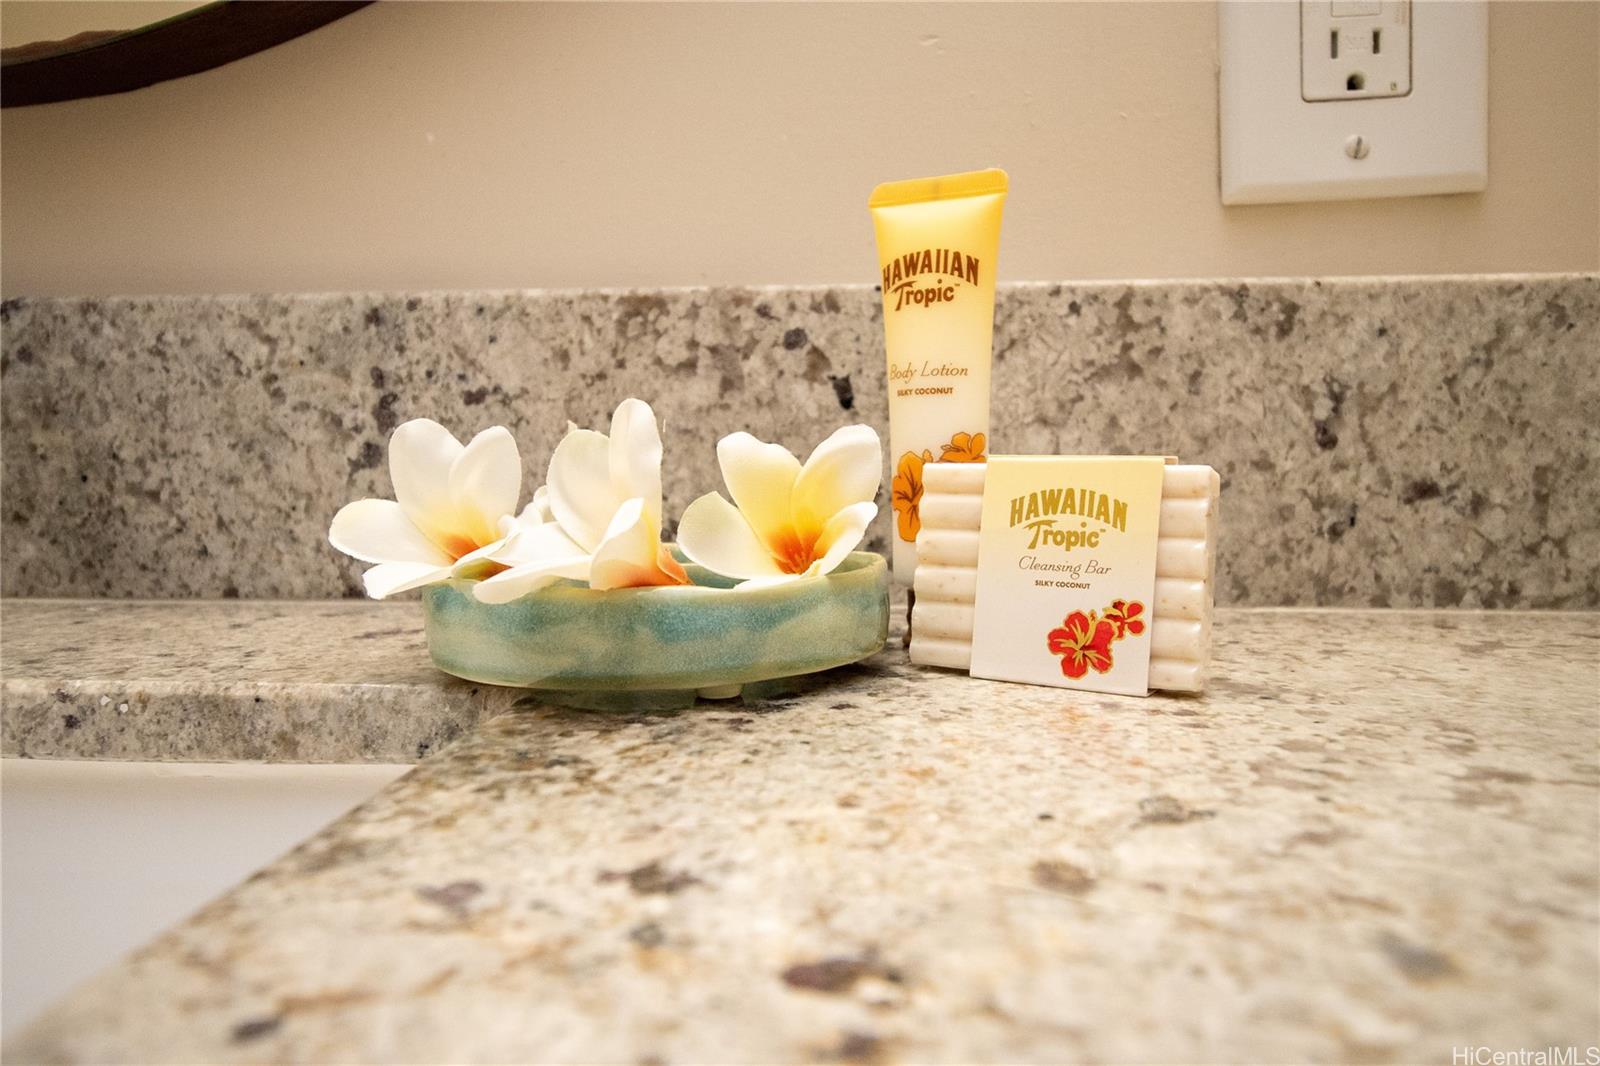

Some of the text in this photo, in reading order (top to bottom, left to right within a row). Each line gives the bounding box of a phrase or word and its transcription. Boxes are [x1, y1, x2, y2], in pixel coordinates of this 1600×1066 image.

[883, 249, 980, 295] HAWAIIAN
[890, 360, 969, 384] Body Lotion
[915, 387, 954, 396] COCONUT
[1009, 488, 1129, 533] HAWAIIAN
[1018, 555, 1112, 580] Cleansing Bar
[1035, 579, 1091, 590] SILKY COCONUT
